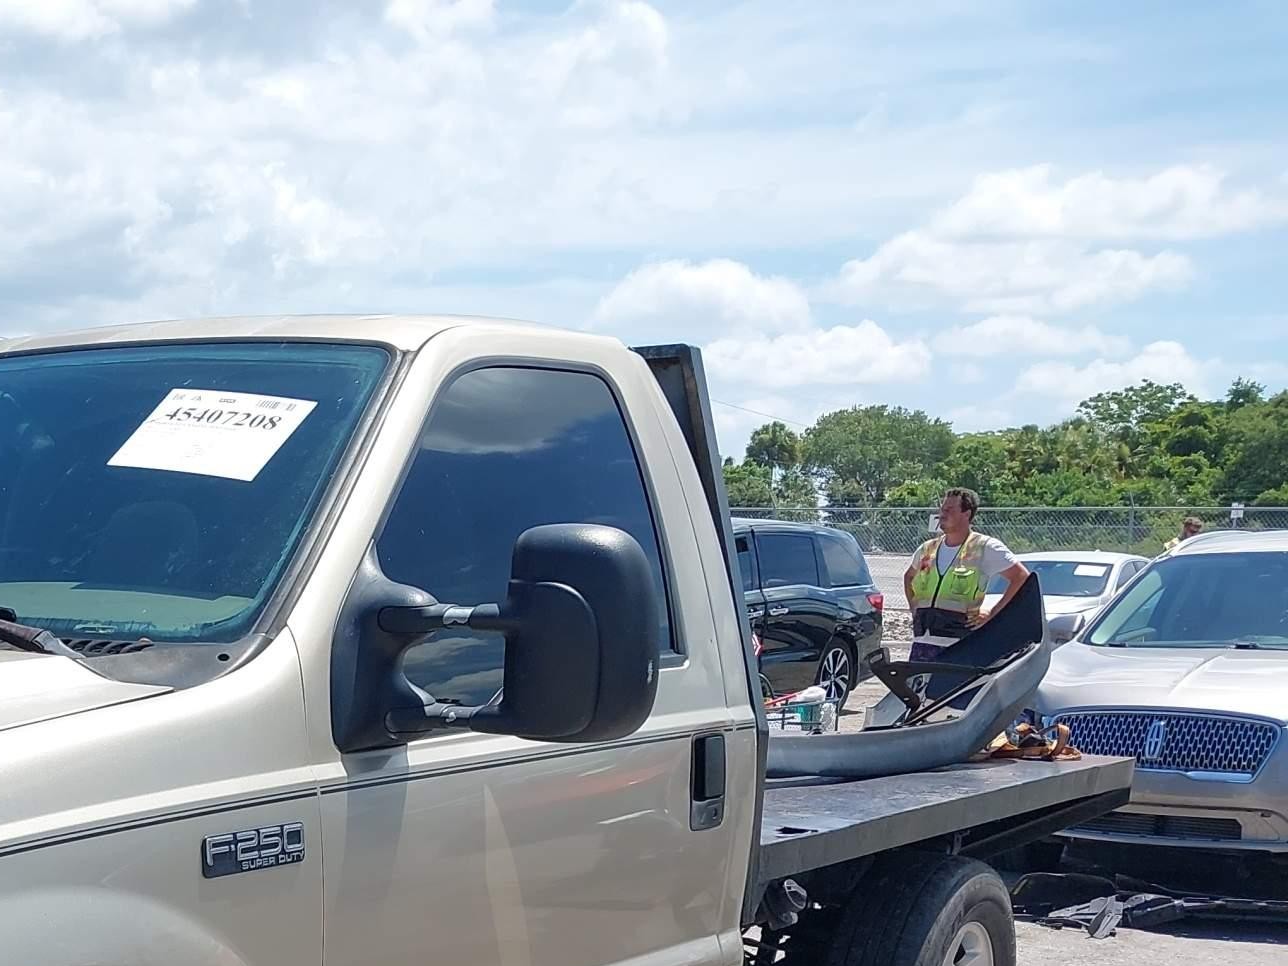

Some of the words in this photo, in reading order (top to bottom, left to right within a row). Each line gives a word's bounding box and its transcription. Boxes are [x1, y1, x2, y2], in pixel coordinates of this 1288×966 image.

[165, 407, 282, 430] 45407208
[242, 856, 276, 870] SUPER
[278, 850, 304, 864] DUTY
